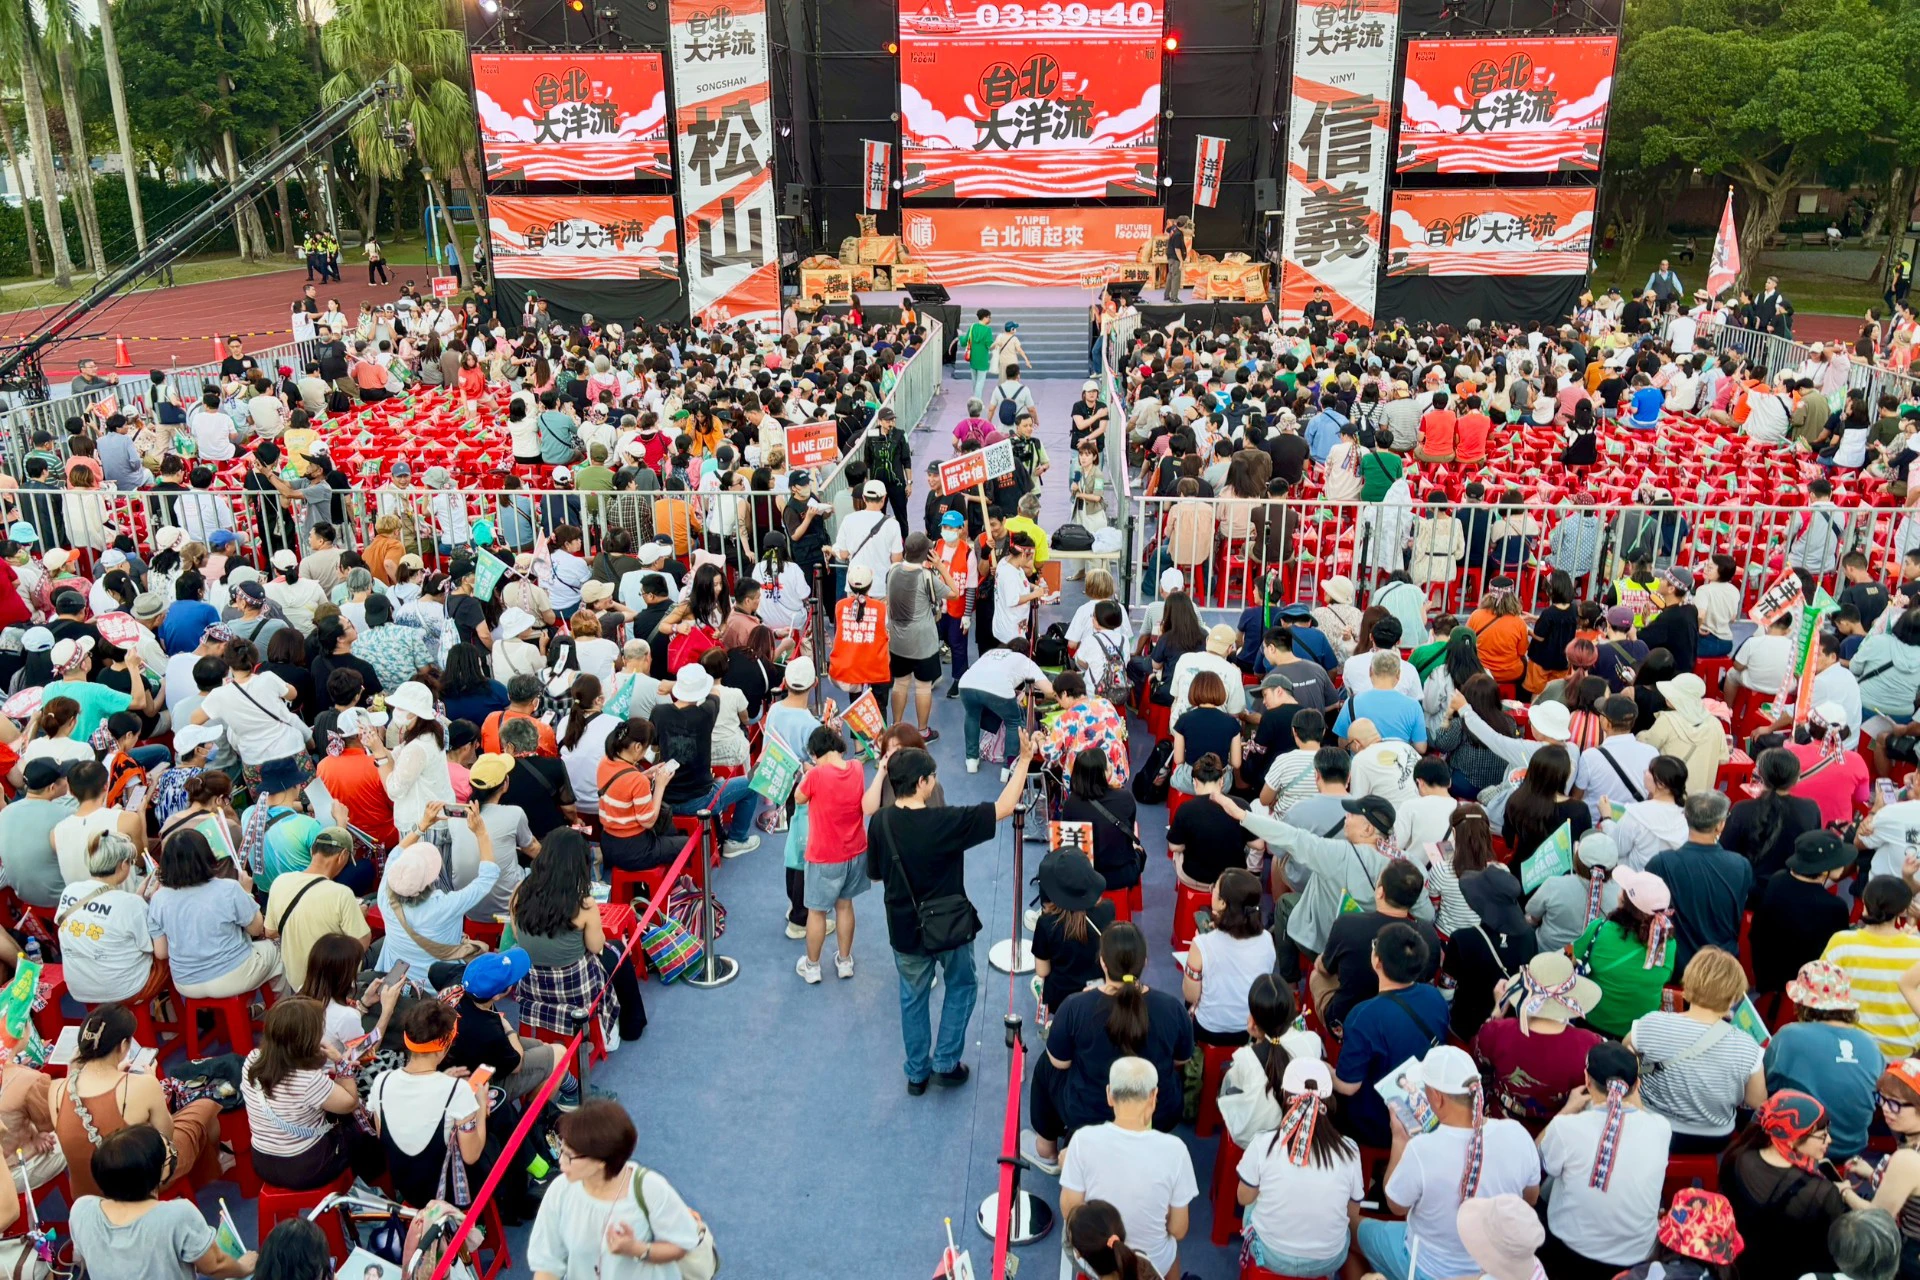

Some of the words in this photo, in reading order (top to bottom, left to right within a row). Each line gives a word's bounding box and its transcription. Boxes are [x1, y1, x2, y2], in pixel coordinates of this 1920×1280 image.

[687, 7, 732, 36] 台北
[976, 2, 1154, 27] 03:39:40
[1315, 0, 1361, 27] 台北
[683, 29, 756, 63] 大洋流
[1306, 20, 1385, 56] 大洋流
[534, 69, 589, 108] 台北
[696, 76, 747, 94] SONGSHAN
[982, 55, 1057, 106] 台北
[1329, 72, 1356, 84] XINYI
[1470, 53, 1529, 98] 台北
[533, 99, 620, 144] 大洋流
[972, 94, 1095, 152] 大洋流
[1456, 85, 1558, 135] 大洋流
[687, 99, 765, 278] 松山
[868, 161, 887, 192] 洋流
[1199, 157, 1220, 189] 洋流
[1293, 93, 1381, 268] 信義
[524, 222, 571, 250] 台北
[576, 218, 644, 249] 大洋流
[912, 223, 932, 246] 順
[1015, 216, 1050, 225] TAIPEI
[1118, 230, 1149, 239] SOON
[1427, 214, 1479, 245] 台北
[1481, 211, 1558, 244] 大洋流
[980, 226, 1084, 247] 台北順起來
[1124, 270, 1150, 280] 洋流
[792, 439, 815, 455] LINE
[818, 438, 833, 448] VIP
[947, 466, 984, 490] 瓶中信
[842, 630, 875, 644] 沈伯洋
